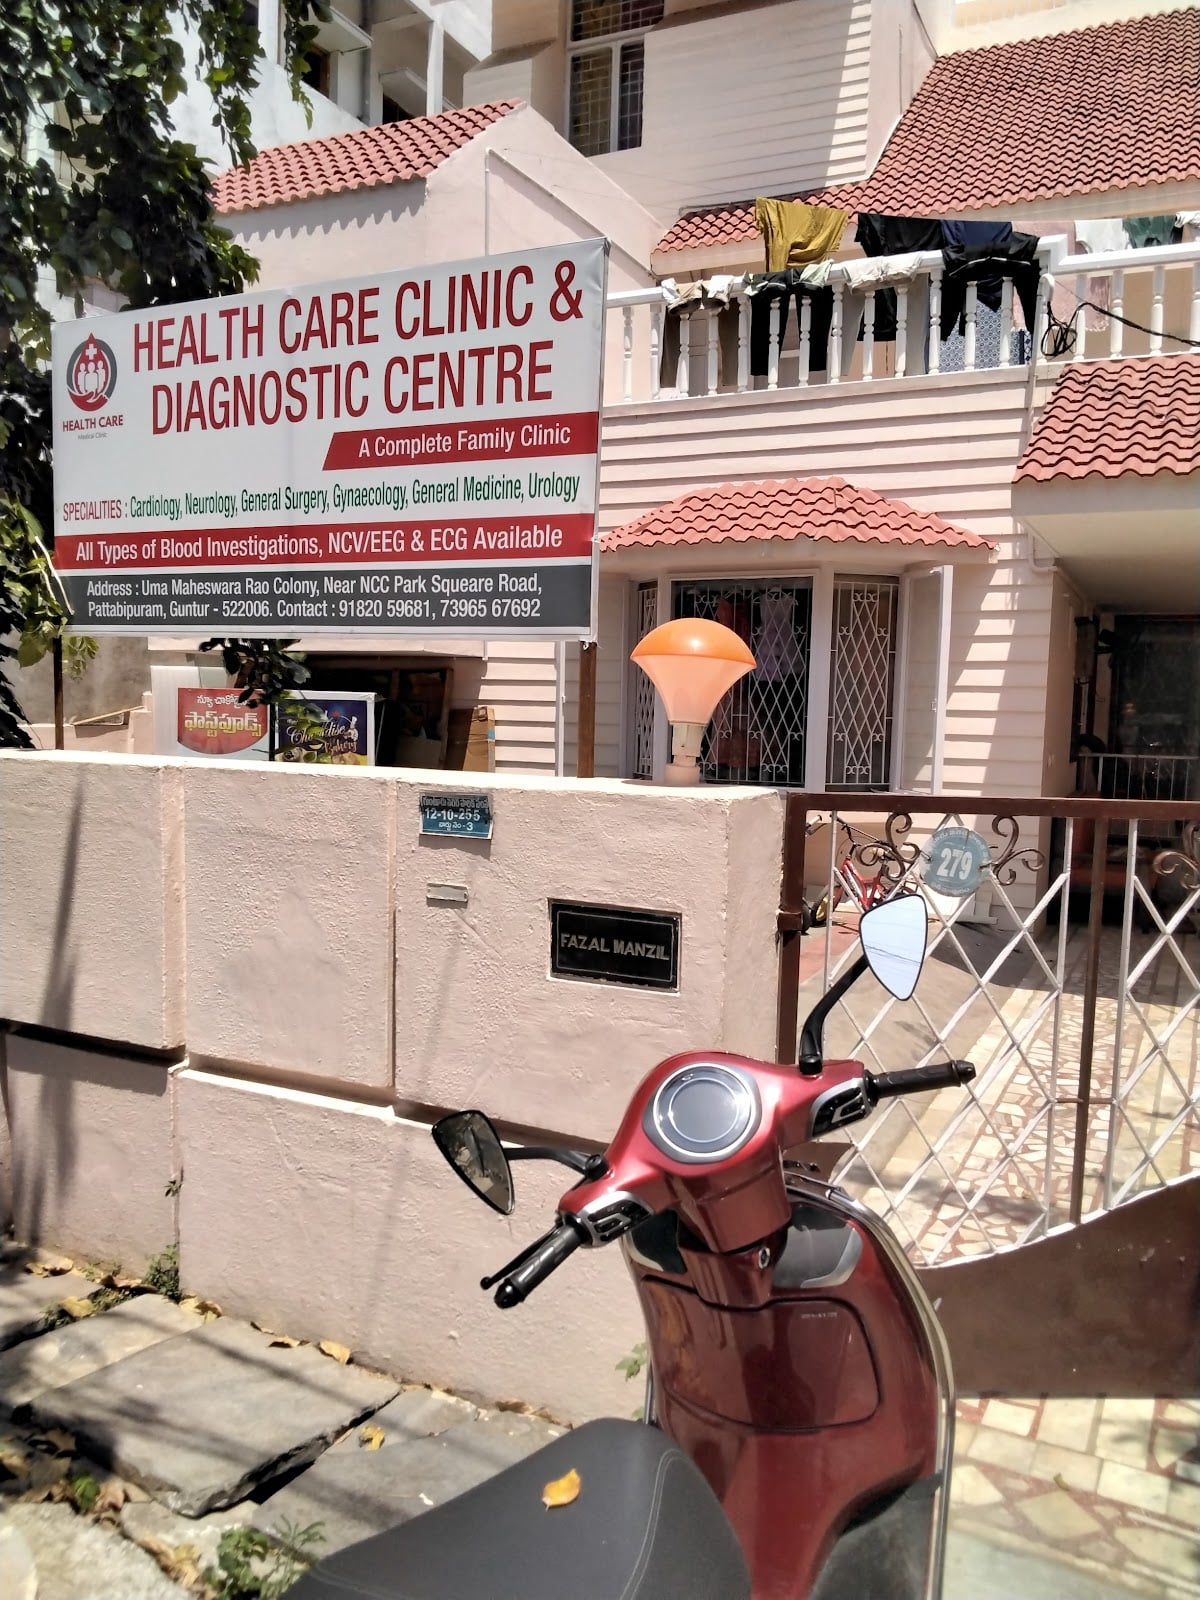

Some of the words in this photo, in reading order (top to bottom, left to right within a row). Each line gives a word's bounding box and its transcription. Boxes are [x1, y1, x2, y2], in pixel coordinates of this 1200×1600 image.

[133, 304, 264, 373] HEALTH
[279, 287, 380, 354] CARE
[395, 265, 534, 340] CLINIC
[549, 260, 584, 322] &
[152, 360, 369, 435] DIAGNOSTIC
[383, 340, 554, 414] CENTRE
[62, 418, 97, 433] HEALTH
[98, 415, 124, 428] CARE
[358, 438, 371, 458] A
[374, 432, 452, 460] Complete
[457, 427, 515, 453] Family
[520, 423, 571, 447] Clinic
[63, 499, 122, 522] SPECIALITIES
[130, 495, 183, 521] Cardiology,
[185, 490, 239, 519] Neurology,
[241, 488, 282, 513] General
[284, 486, 330, 514] Surgery,
[333, 481, 409, 513] Gynaecology,
[412, 476, 459, 504] General
[463, 473, 524, 503] Medicine,
[528, 471, 581, 503] Urology
[76, 541, 94, 562] All
[97, 540, 138, 565] Types
[142, 539, 157, 560] of
[160, 537, 202, 559] Blood
[207, 534, 323, 561] Investigations,
[328, 530, 405, 554] NCV/EEG
[410, 529, 425, 553] &
[430, 527, 468, 552] ECG
[473, 524, 563, 551] Available
[86, 580, 133, 597] Address
[142, 580, 168, 596] Uma
[171, 578, 242, 596] Maheswara
[245, 577, 270, 595] Rao
[273, 576, 320, 597] Colony,
[323, 575, 356, 594] Near
[360, 575, 390, 594] NCC
[394, 574, 427, 594] Park
[431, 574, 494, 596] Squeare
[498, 572, 542, 595] Road,
[88, 600, 167, 620] Pattabipuram,
[169, 600, 210, 618] Guntur
[222, 600, 273, 618] 522006.
[277, 600, 328, 617] Contact
[339, 600, 383, 618] 91820
[386, 599, 436, 620] 59681,
[440, 599, 488, 618] 73965
[491, 598, 541, 618] 67692
[424, 807, 481, 822] 12-10-255
[466, 822, 474, 831] 3
[936, 847, 973, 881] 279
[560, 932, 611, 953] FAZAL
[613, 939, 670, 961] MANZIL
